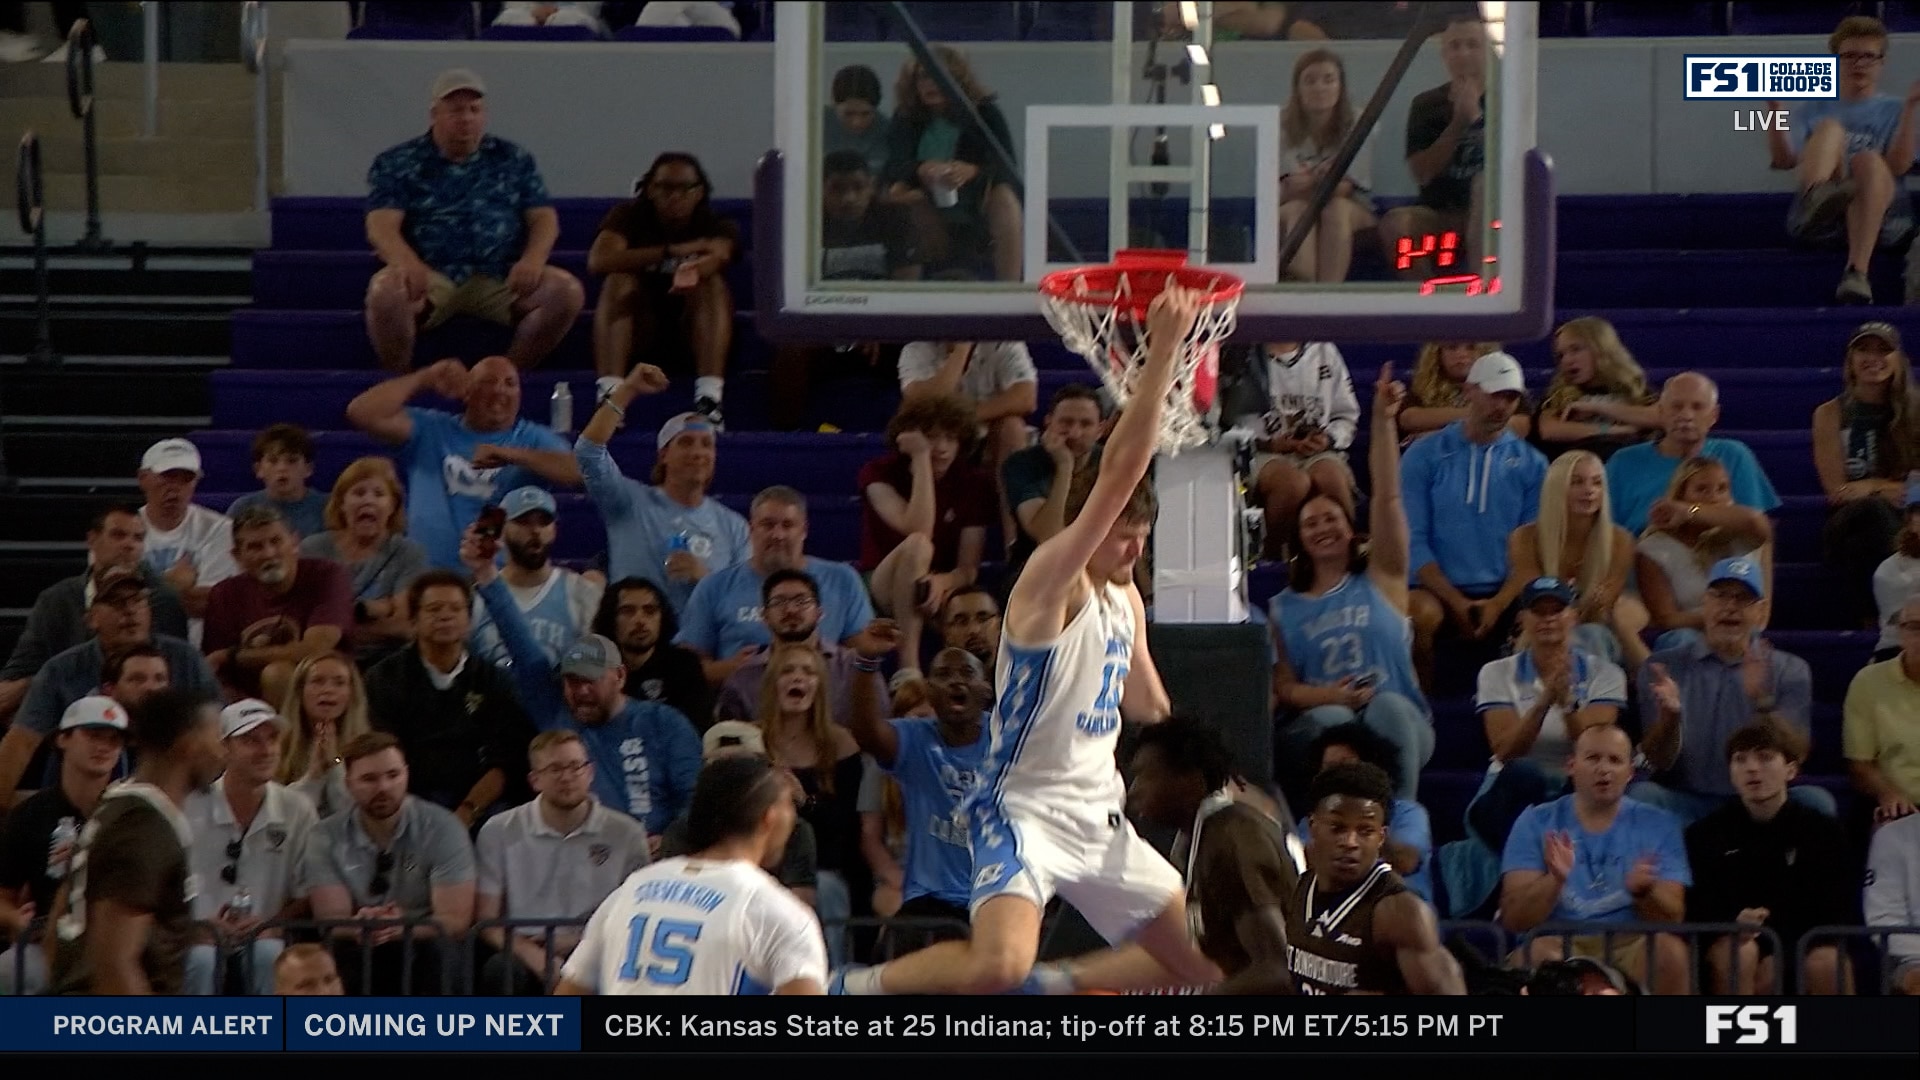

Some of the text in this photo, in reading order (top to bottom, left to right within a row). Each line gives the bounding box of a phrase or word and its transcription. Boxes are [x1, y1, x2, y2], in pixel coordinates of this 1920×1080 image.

[1320, 632, 1364, 674] 23
[634, 879, 726, 914] STEVENSON
[618, 912, 704, 986] 15
[1294, 947, 1359, 988] BONAVENTURE
